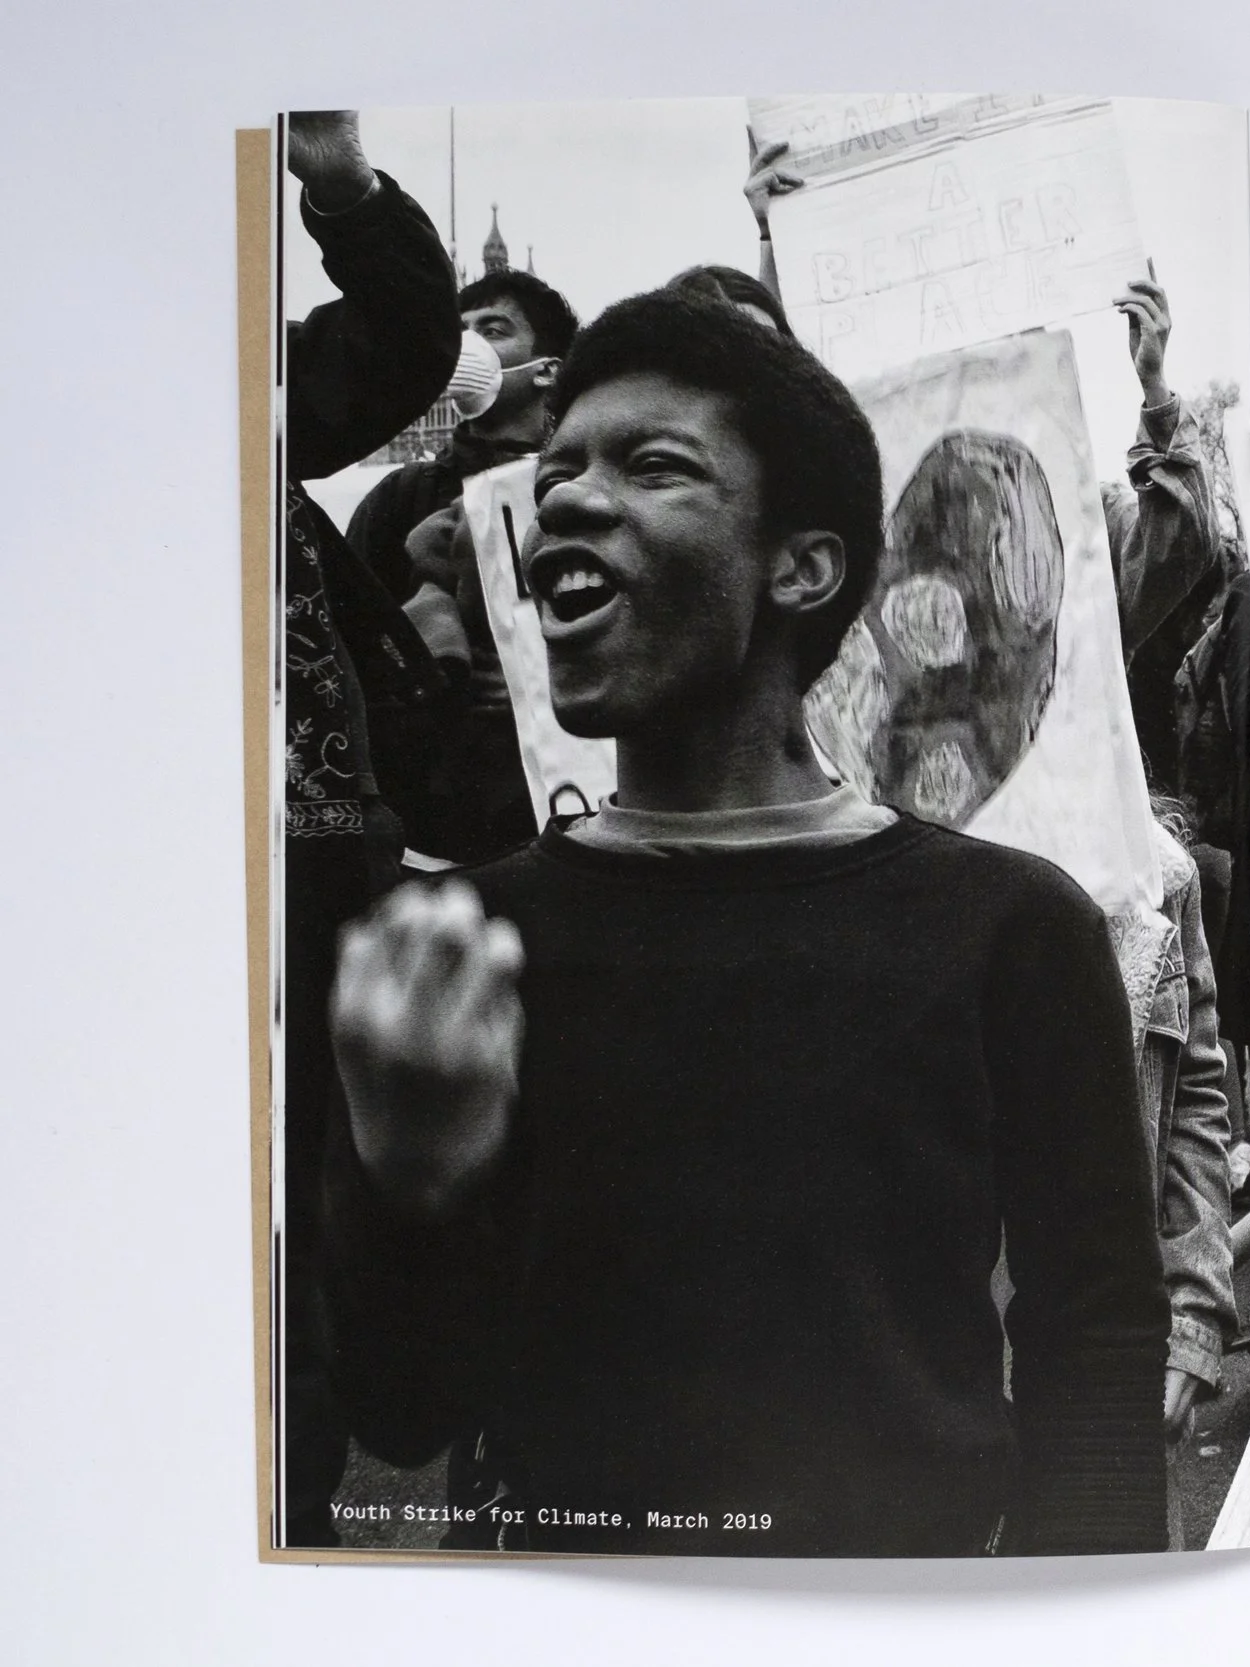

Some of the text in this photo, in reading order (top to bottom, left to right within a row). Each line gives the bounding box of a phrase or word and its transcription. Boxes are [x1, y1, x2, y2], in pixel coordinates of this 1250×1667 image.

[791, 94, 940, 167] MAKE
[927, 160, 970, 212] A
[812, 182, 1084, 305] BETTER
[331, 1504, 771, 1529] Youth Strike for Climate, March 2019
